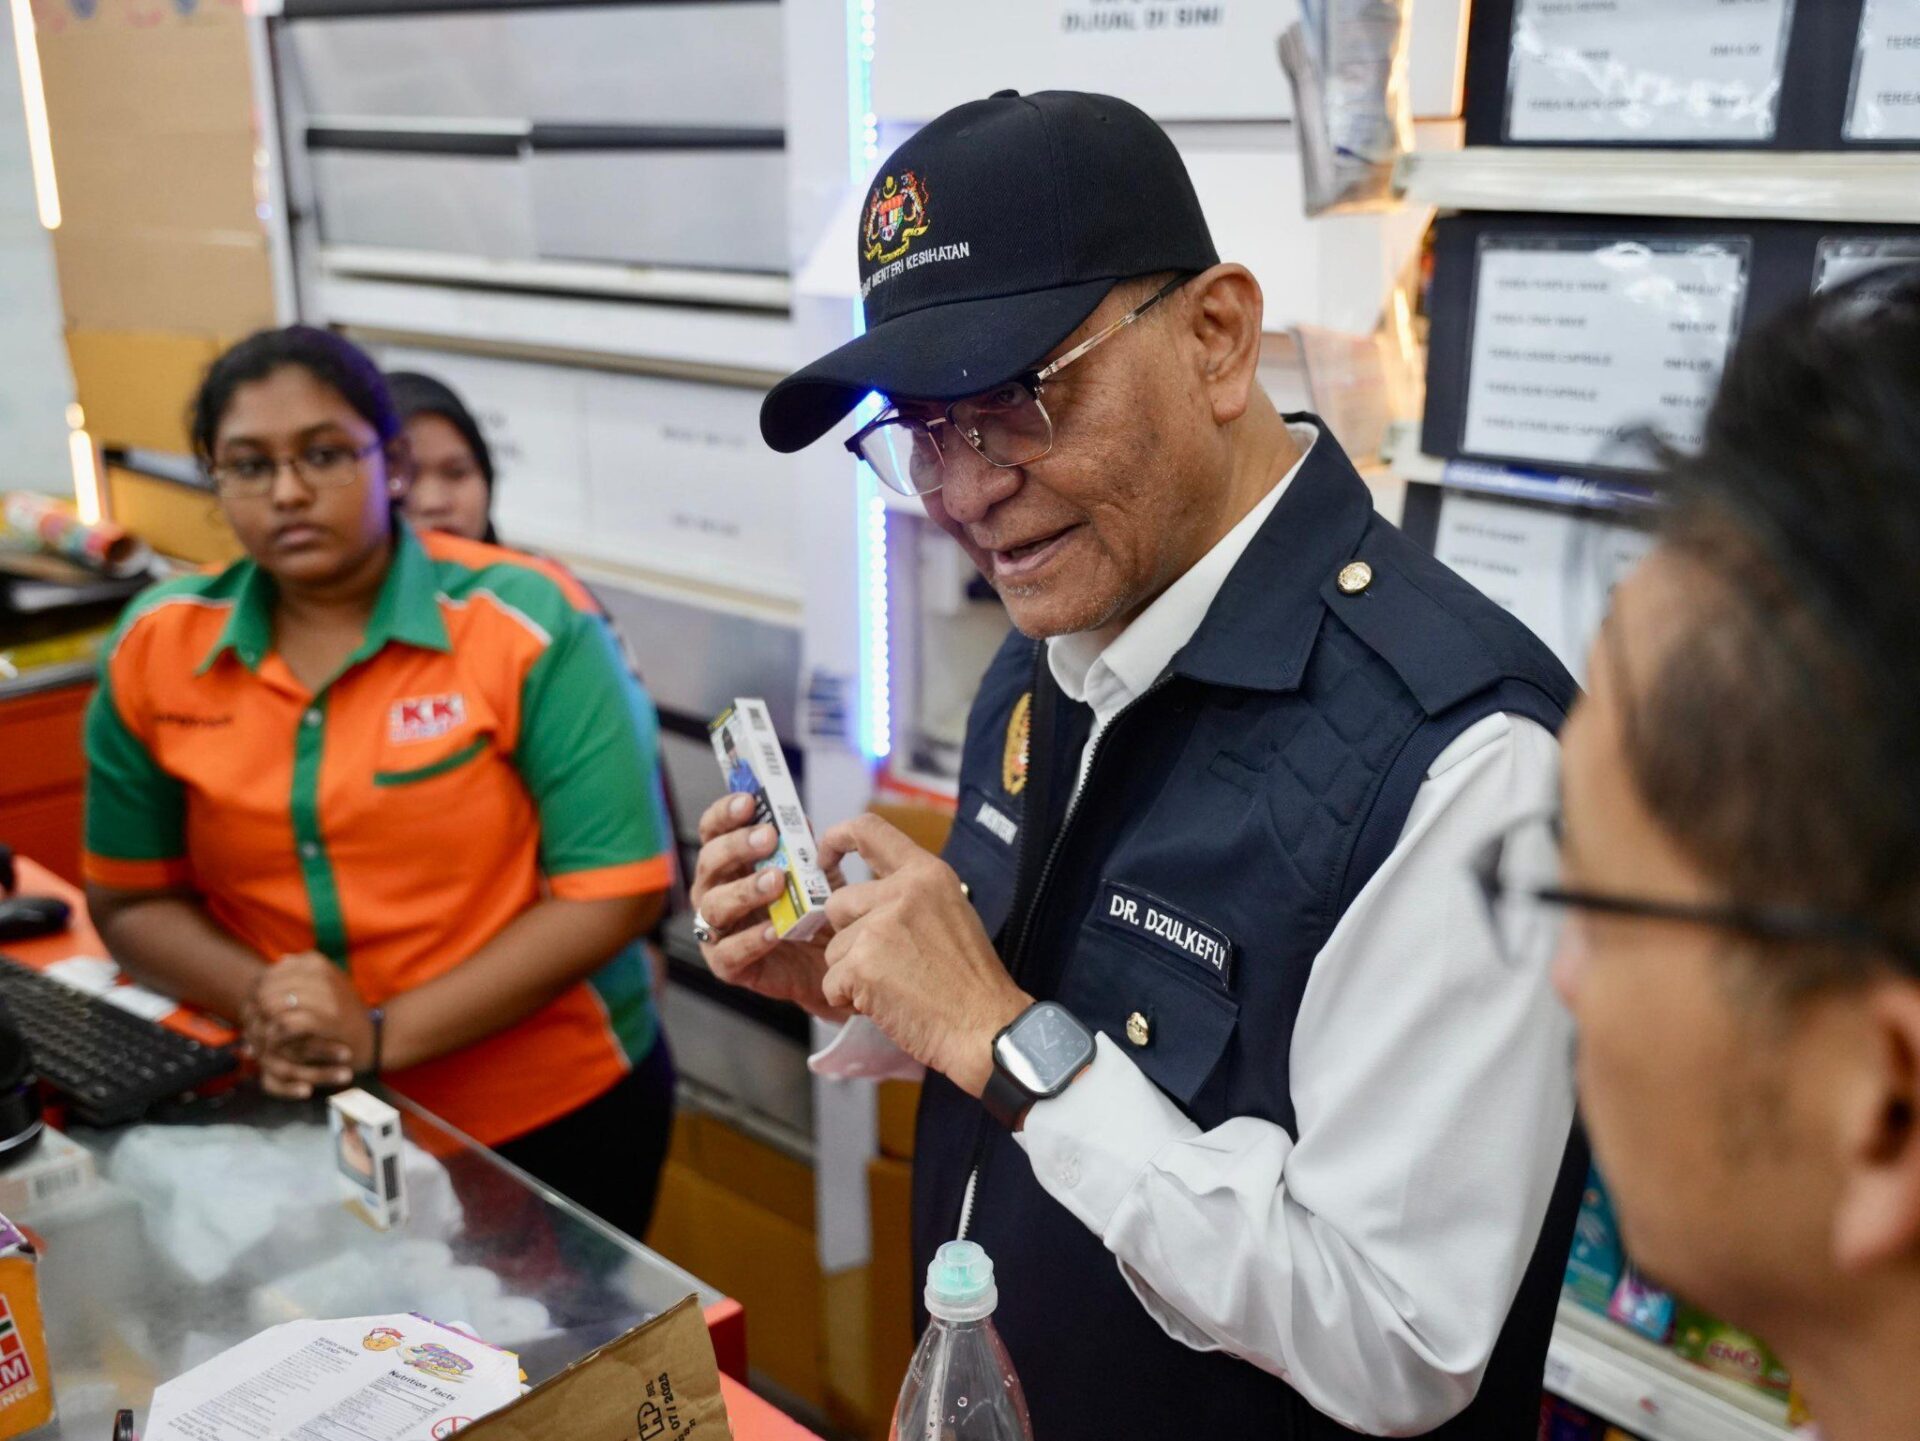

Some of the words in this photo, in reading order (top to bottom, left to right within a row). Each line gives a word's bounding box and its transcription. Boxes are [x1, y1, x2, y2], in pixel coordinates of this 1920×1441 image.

[1146, 10, 1165, 28] DI
[872, 260, 904, 288] MENTERI
[906, 241, 970, 270] KESIHATAN
[1109, 894, 1139, 925] DR.
[1144, 908, 1226, 970] DZULKEFLY
[0, 1382, 38, 1411] NCE
[389, 1369, 428, 1390] Nutrition
[430, 1386, 457, 1401] Facts
